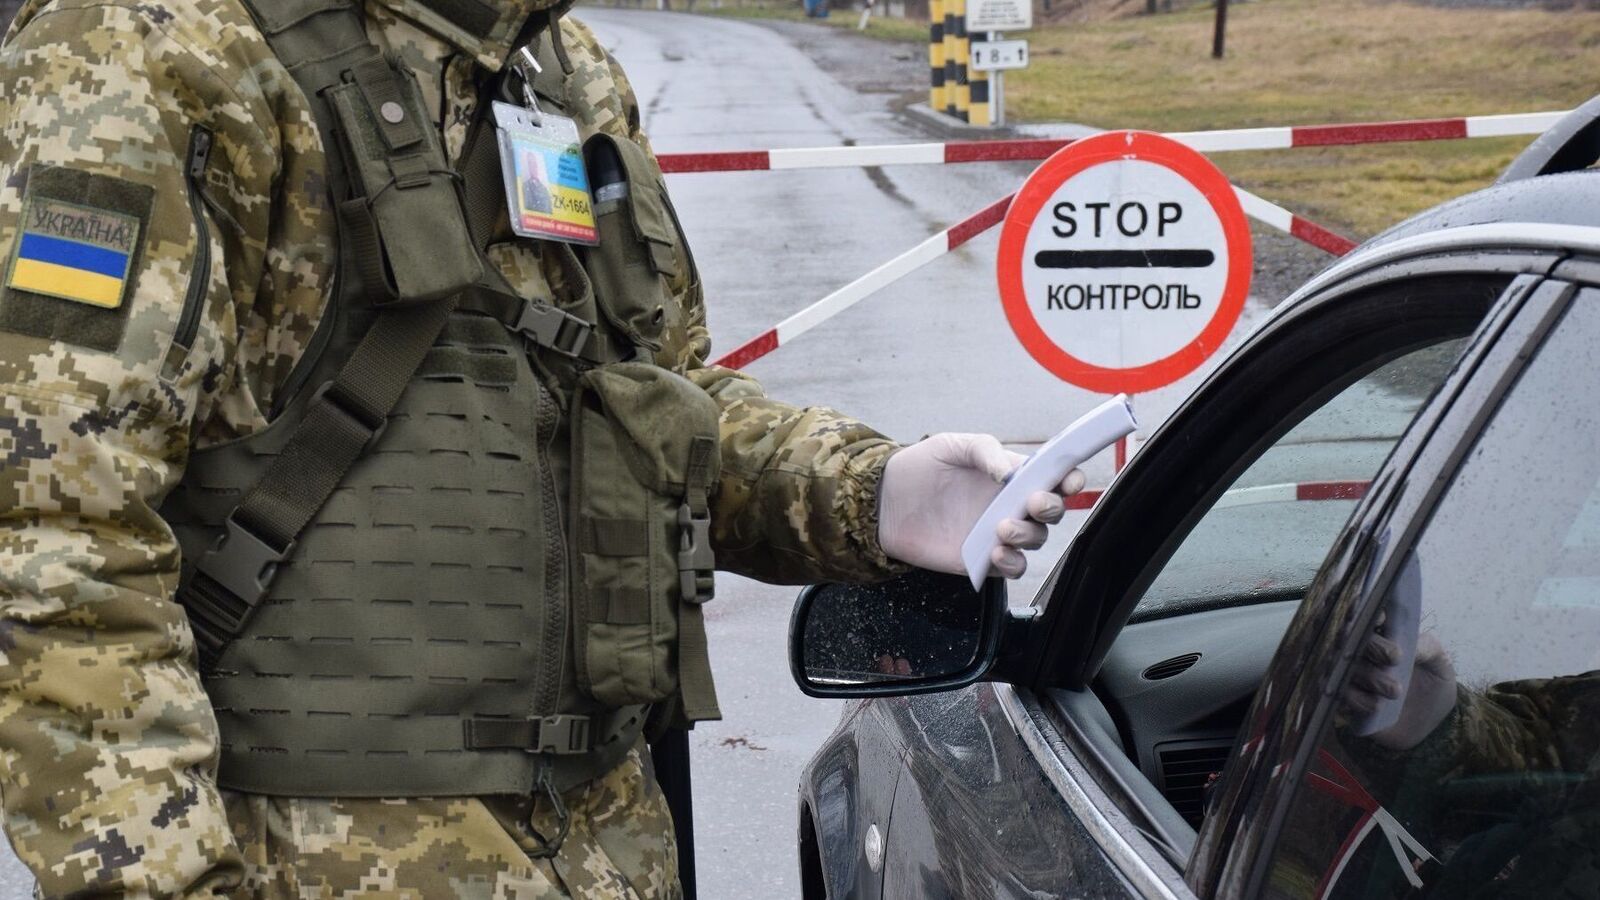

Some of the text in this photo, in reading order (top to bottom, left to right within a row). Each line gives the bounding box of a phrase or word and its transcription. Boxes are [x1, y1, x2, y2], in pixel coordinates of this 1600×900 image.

[553, 194, 590, 215] ZK-1664
[1052, 201, 1183, 238] STOP
[32, 206, 128, 247] УКРАЇНА
[1047, 284, 1201, 310] КОНТРОЛЬ
